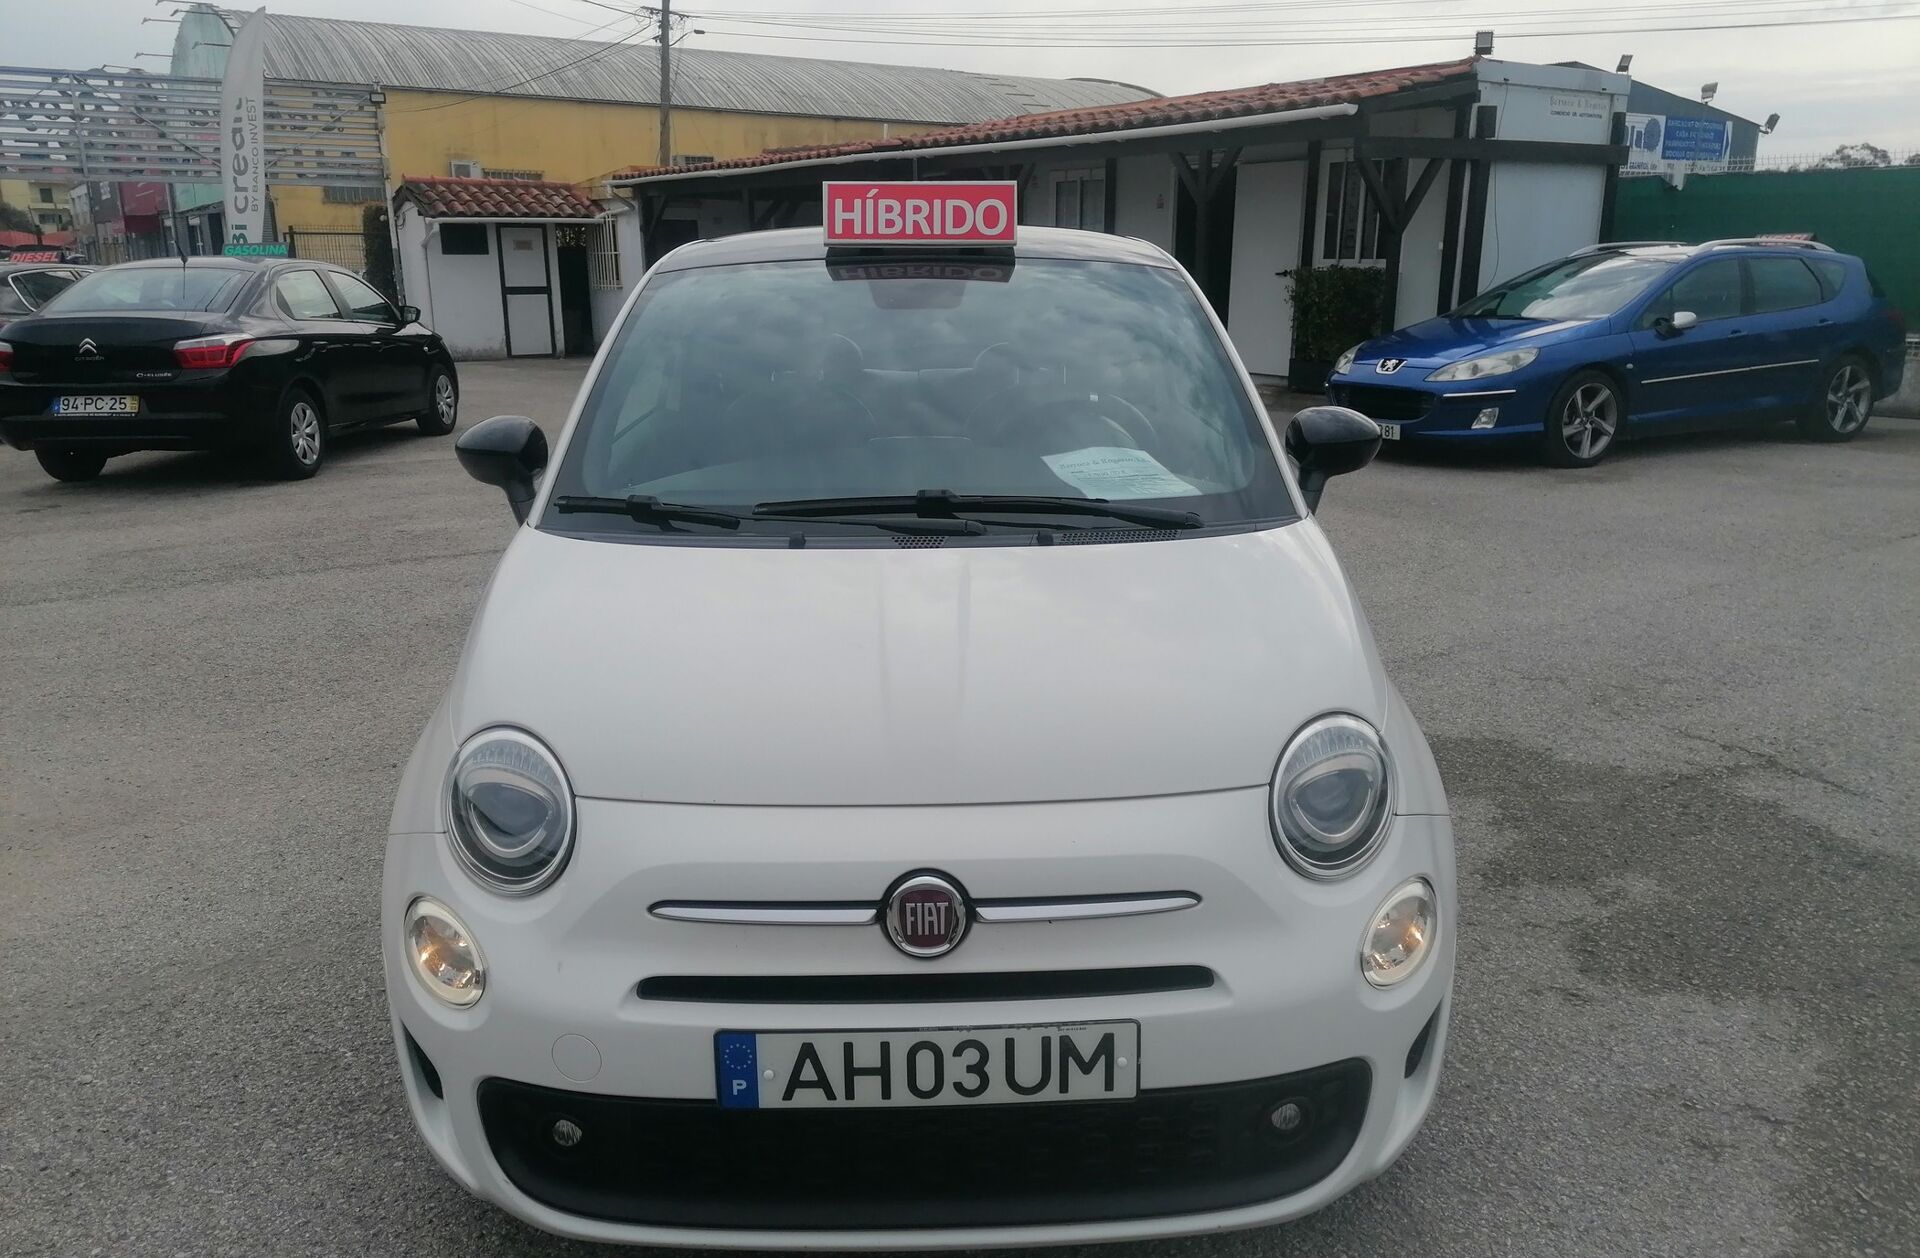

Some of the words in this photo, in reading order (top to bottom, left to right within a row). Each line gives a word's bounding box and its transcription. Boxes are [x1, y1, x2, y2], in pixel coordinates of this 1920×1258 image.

[245, 97, 258, 145] INVEST
[251, 147, 259, 193] BANCO
[251, 196, 259, 212] BY
[835, 188, 1007, 235] HÍBRIDO
[11, 251, 59, 263] DIESEL
[224, 244, 288, 256] GASOLINA
[905, 902, 949, 936] FIAT
[732, 1079, 747, 1096] P
